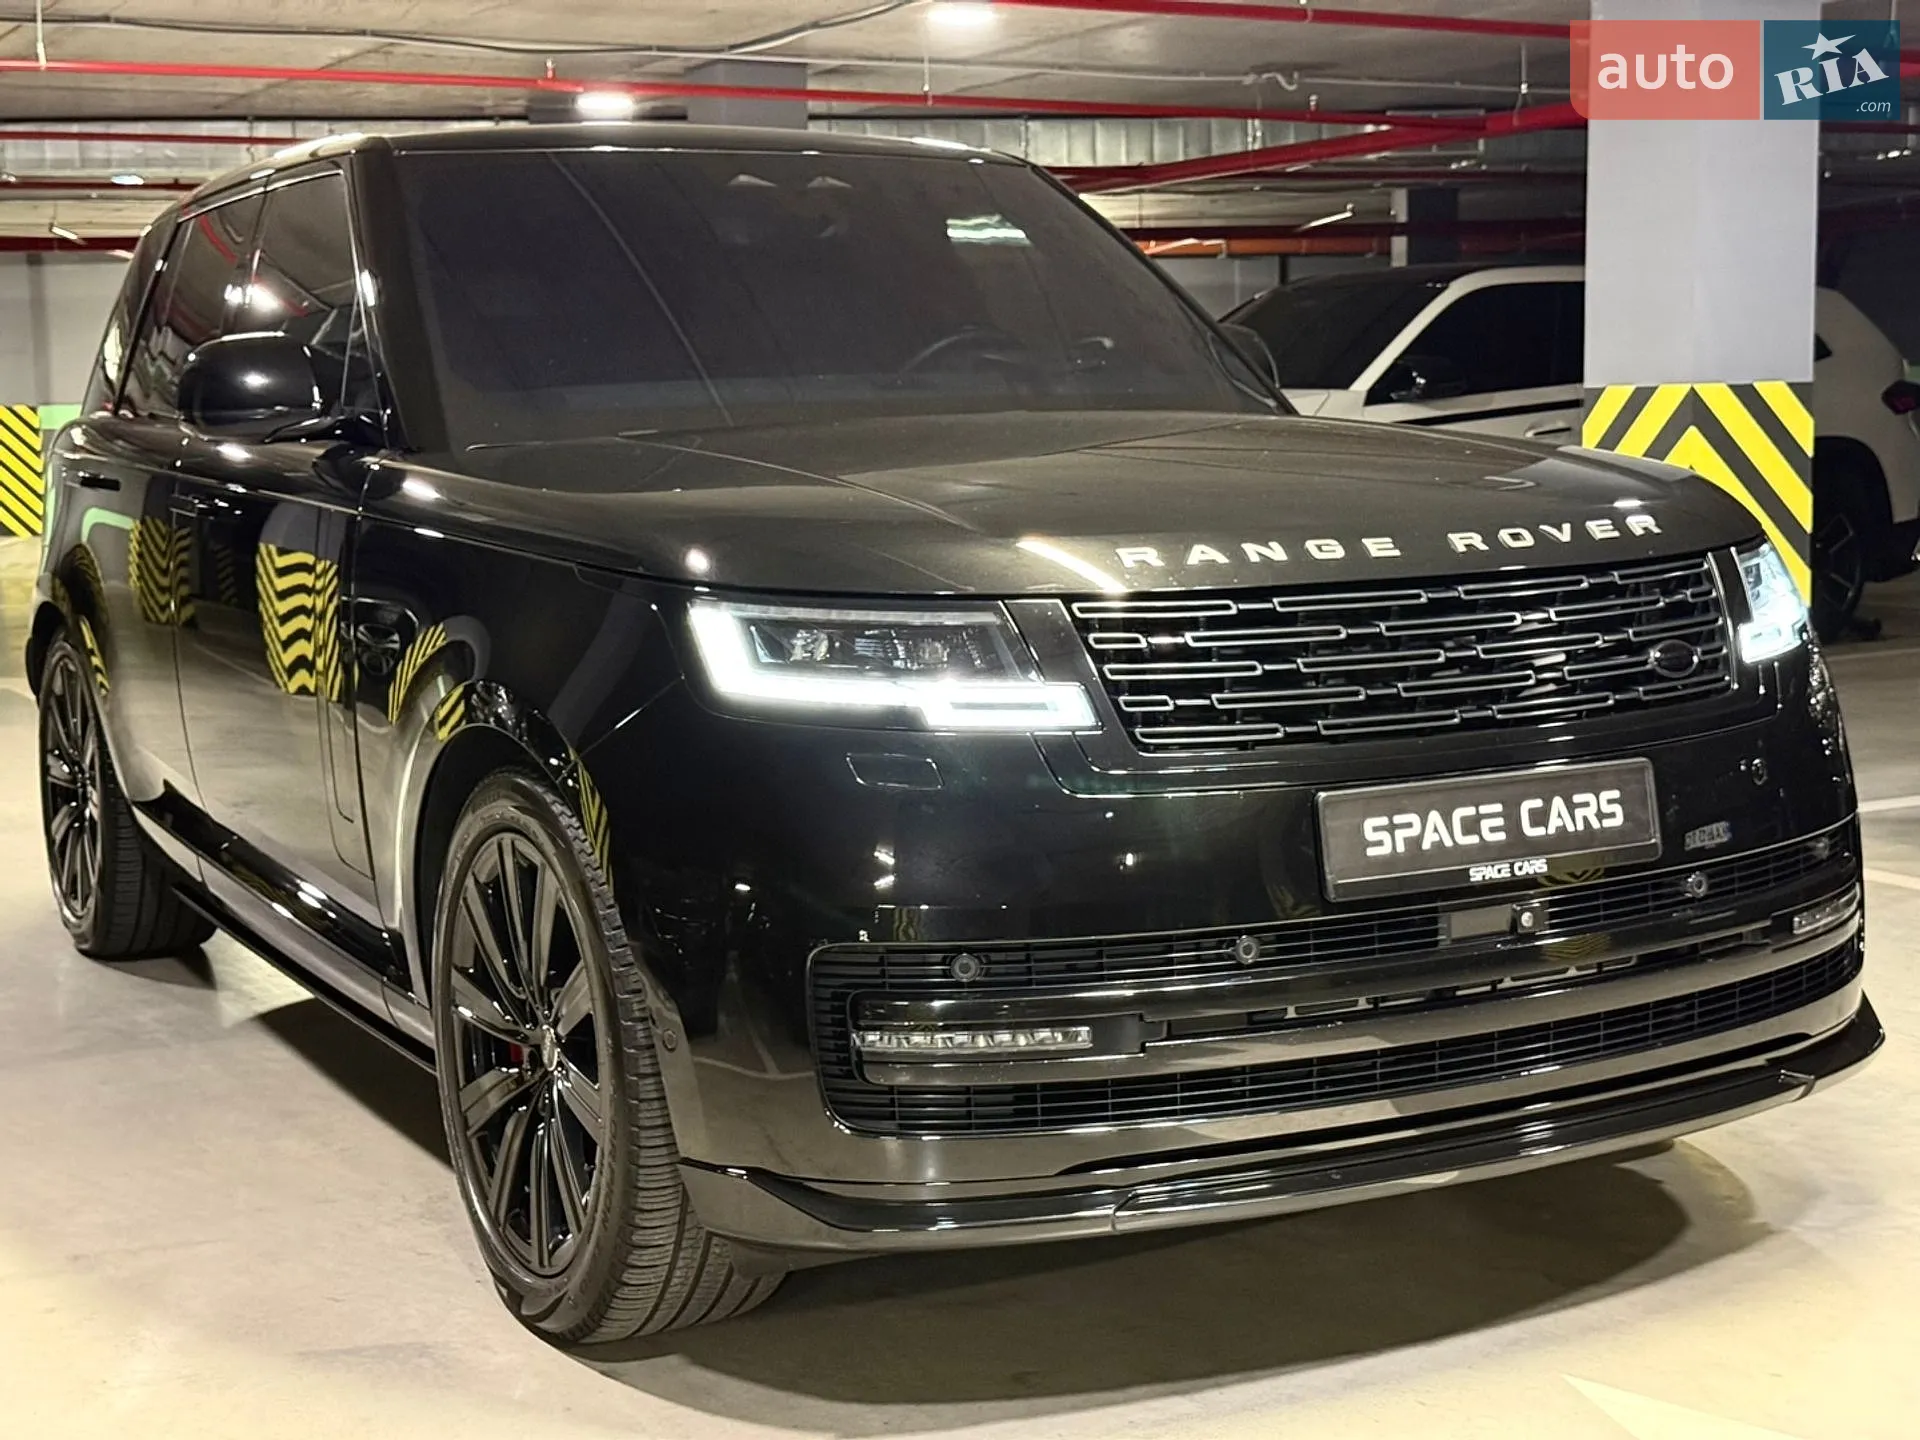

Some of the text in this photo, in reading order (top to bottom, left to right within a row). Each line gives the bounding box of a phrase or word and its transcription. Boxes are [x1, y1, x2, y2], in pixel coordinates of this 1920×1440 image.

[1115, 513, 1664, 569] RANGE ROVER
[1362, 802, 1507, 857] SPACE
[1519, 788, 1625, 838] CARS
[1468, 858, 1549, 882] SPACE CARS
